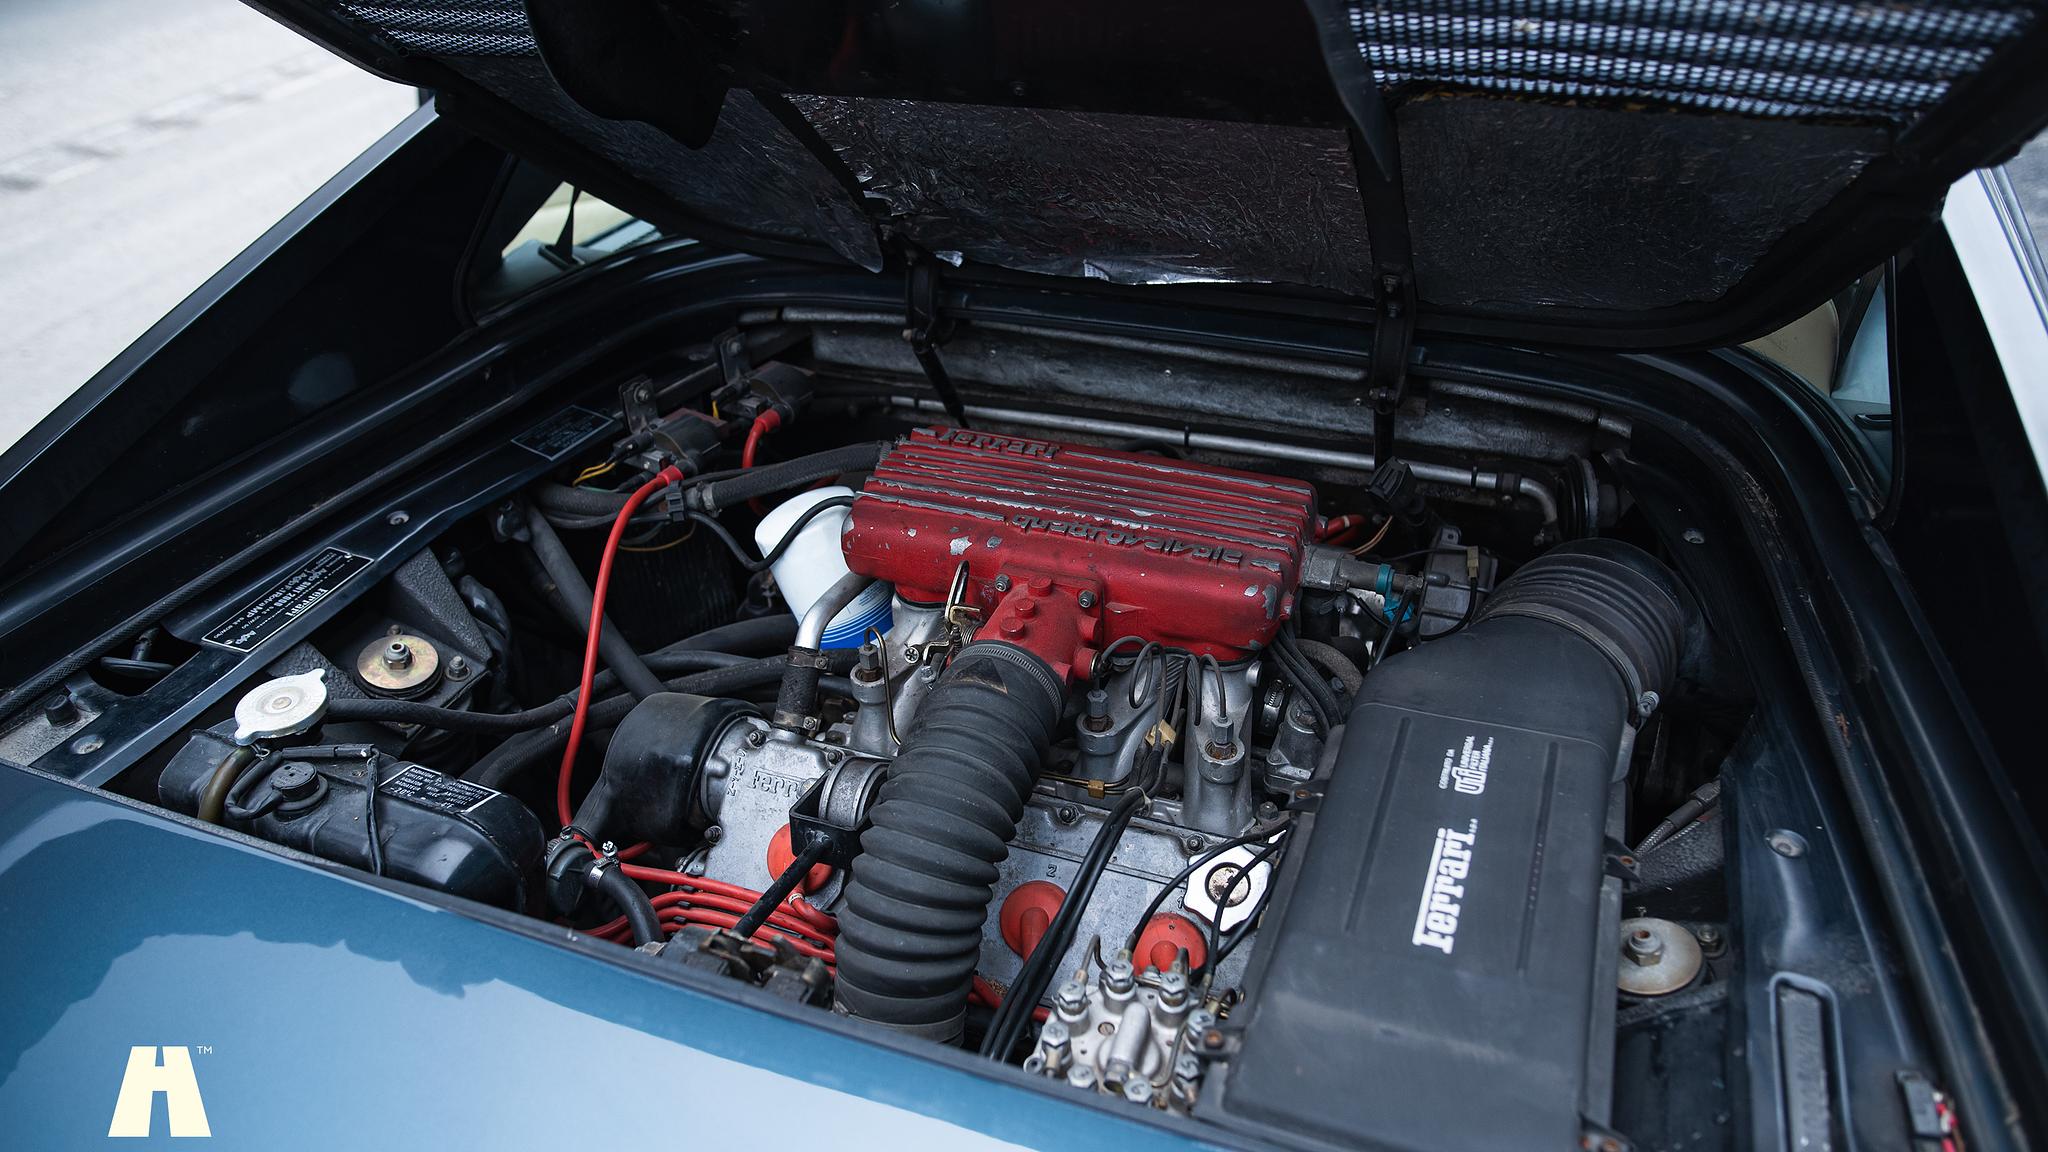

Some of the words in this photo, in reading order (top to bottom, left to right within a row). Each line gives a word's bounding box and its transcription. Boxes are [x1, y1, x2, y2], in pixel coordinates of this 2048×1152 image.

[939, 428, 1060, 459] Ferrari
[1012, 513, 1243, 565] quattrovalvole
[283, 587, 329, 617] Ferrari
[1046, 863, 1058, 878] 2
[1411, 827, 1476, 955] Ferrari
[1111, 963, 1127, 972] 2
[1166, 975, 1180, 984] 3
